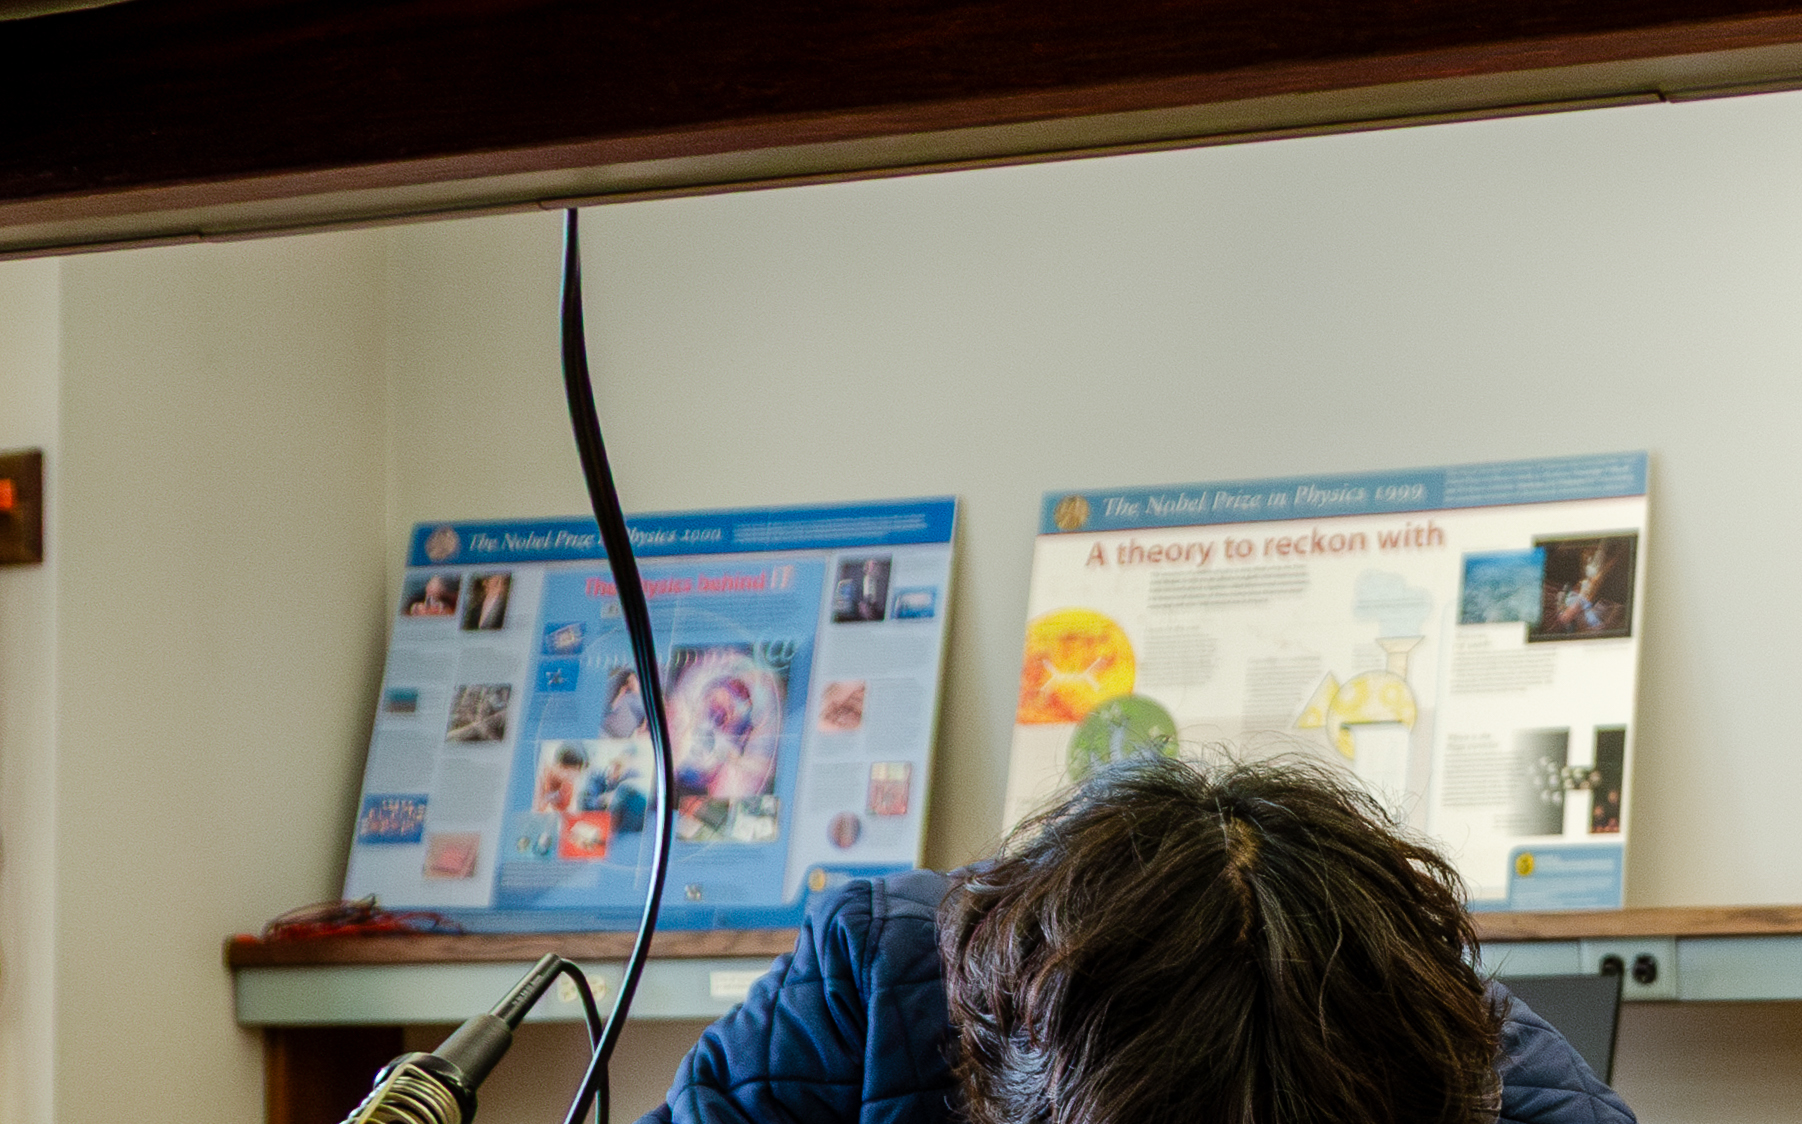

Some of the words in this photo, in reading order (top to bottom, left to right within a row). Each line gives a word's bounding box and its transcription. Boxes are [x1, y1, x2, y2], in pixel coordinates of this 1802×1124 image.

[1103, 496, 1140, 517] The
[1145, 491, 1207, 516] Nobel
[1211, 489, 1263, 512] Prize
[1267, 491, 1288, 507] in
[1293, 484, 1366, 507] Physics
[1374, 483, 1425, 502] 1999
[469, 533, 498, 551] The
[501, 530, 553, 552] Nobel
[626, 526, 678, 547] hysics
[1085, 540, 1106, 567] A
[1116, 537, 1216, 568] theory
[1224, 535, 1254, 560] to
[1262, 527, 1367, 556] reckon
[1377, 519, 1445, 549] with
[697, 571, 767, 592] behind
